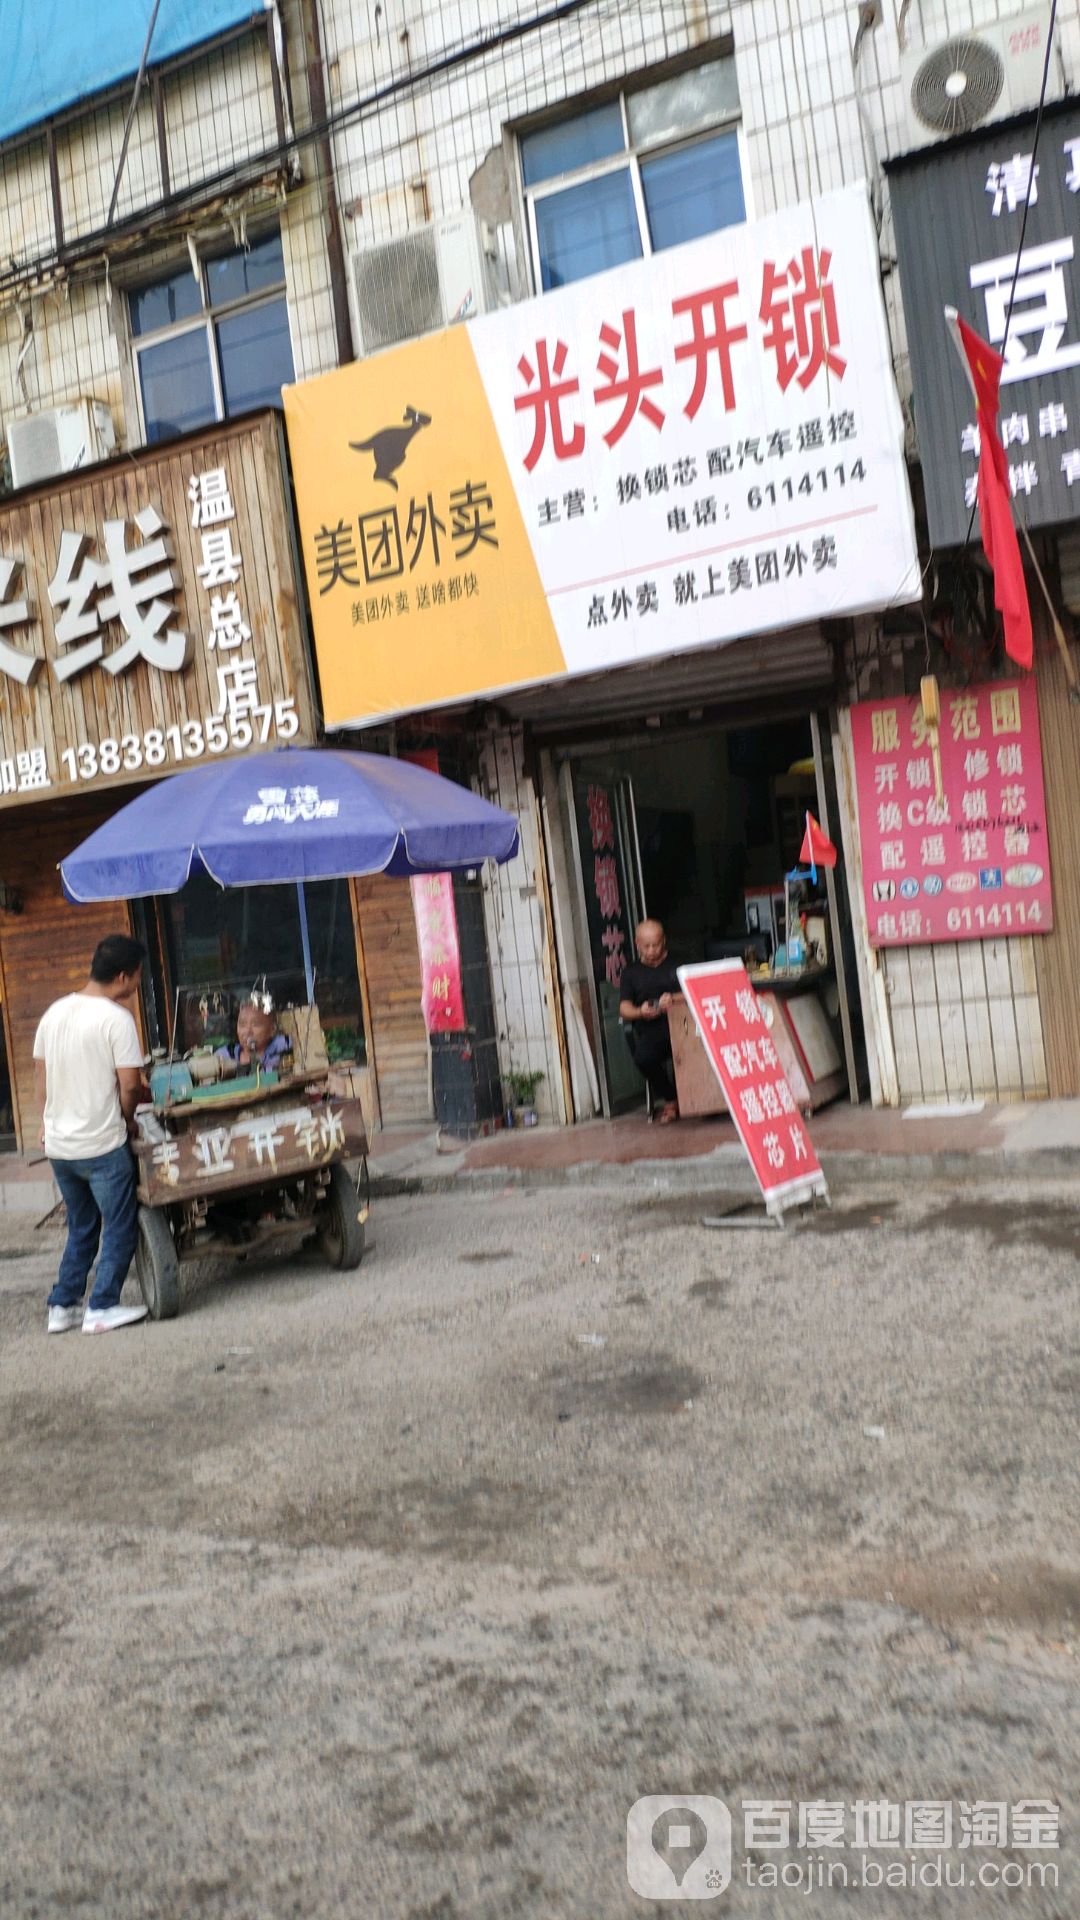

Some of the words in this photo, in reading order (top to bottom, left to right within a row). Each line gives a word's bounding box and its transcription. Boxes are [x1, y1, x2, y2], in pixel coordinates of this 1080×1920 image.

[970, 236, 1080, 386] 豆
[513, 245, 848, 475] 光头开锁
[616, 456, 699, 505] 换锁芯
[705, 409, 859, 478] 配汽车遥控
[746, 456, 868, 512] 6114114
[313, 479, 500, 597] 美团外卖
[188, 466, 260, 718] 温县总店
[350, 593, 410, 628] 美团外卖
[415, 570, 480, 611] 送啥都快
[586, 580, 659, 629] 点外卖
[672, 533, 839, 606] 就上美团外卖
[61, 697, 300, 783] 13838135575
[874, 757, 932, 795] 开锁
[963, 742, 1024, 783] 修锁
[879, 823, 1031, 872] 配遥控器
[946, 898, 1042, 932] 6114114
[702, 988, 761, 1032] 开锁
[719, 1035, 779, 1081] 配汽车
[738, 1077, 798, 1126] 遥控器
[762, 1122, 809, 1169] 芯片
